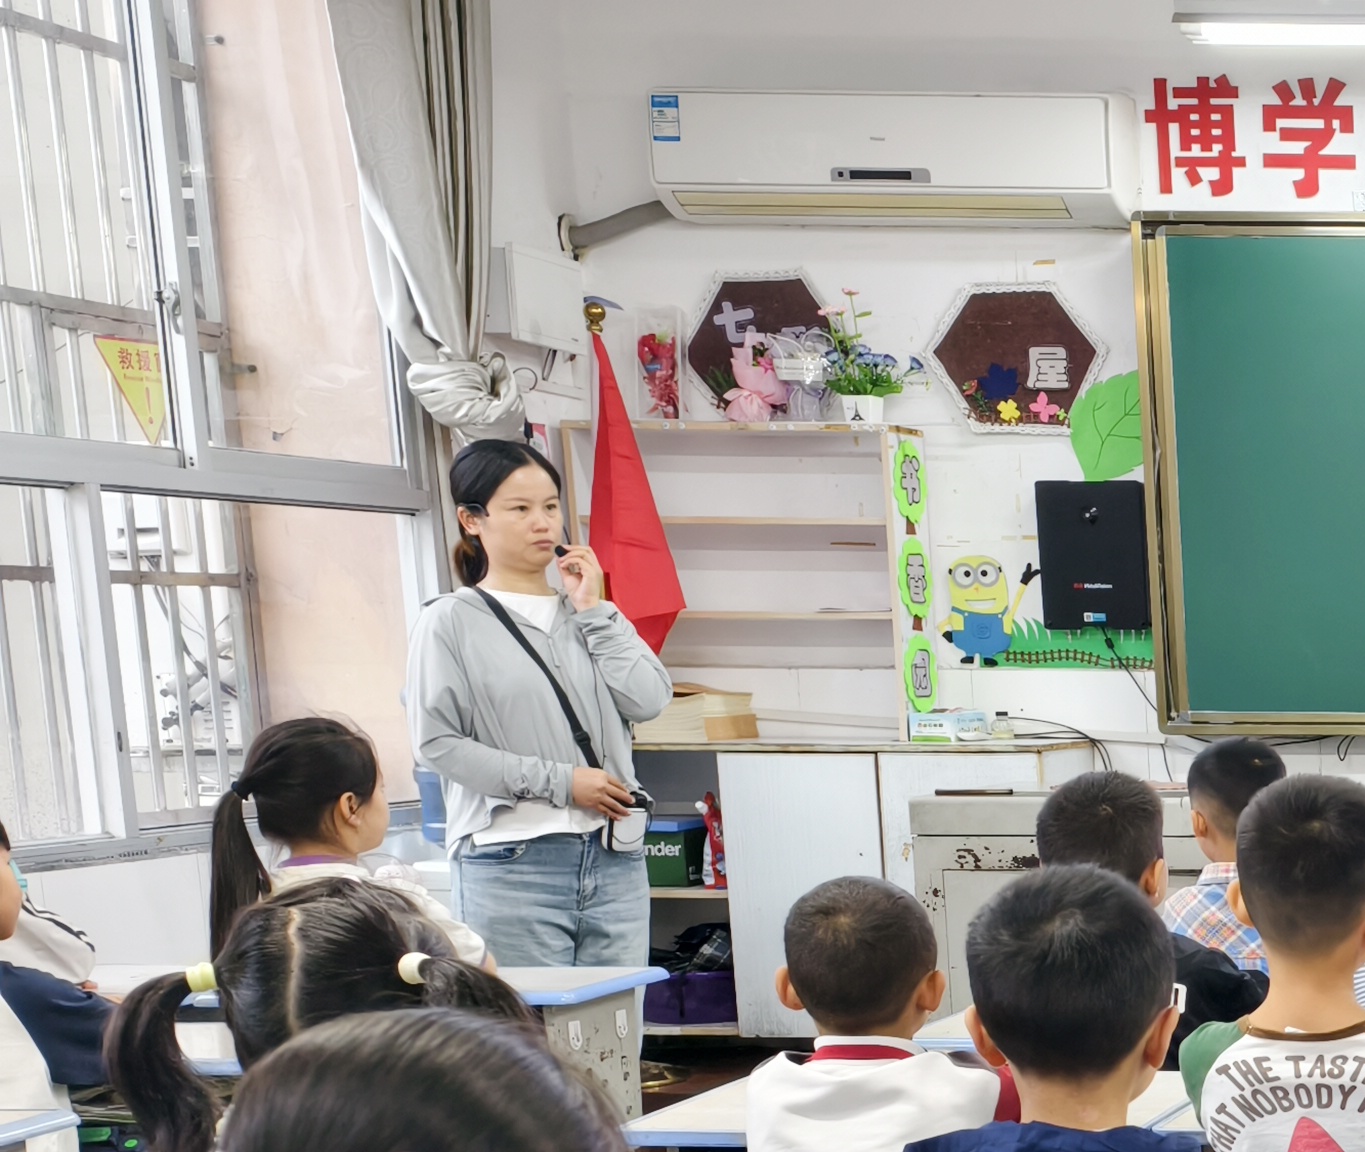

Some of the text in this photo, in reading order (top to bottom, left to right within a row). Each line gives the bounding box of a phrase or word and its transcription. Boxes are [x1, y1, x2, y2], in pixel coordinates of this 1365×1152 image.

[1027, 345, 1070, 390] 屋
[1215, 1056, 1281, 1092] THE
[1230, 1083, 1357, 1122] NOBODY
